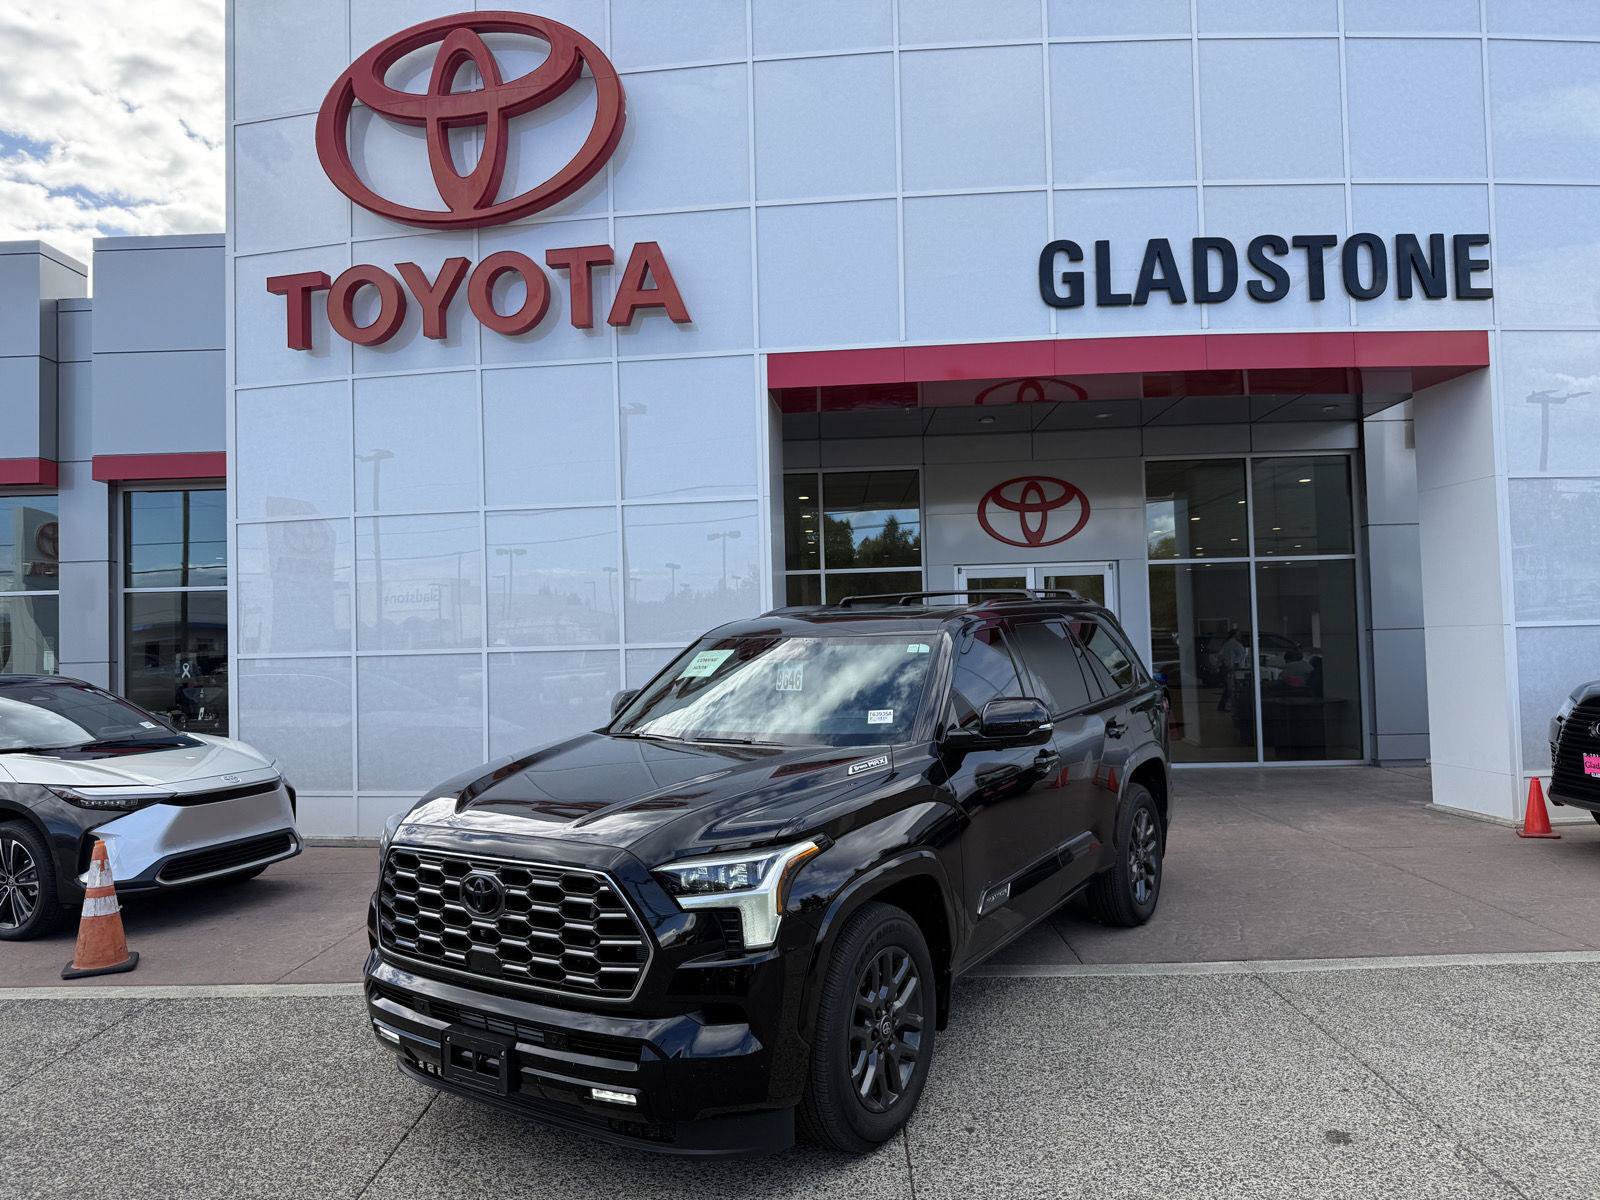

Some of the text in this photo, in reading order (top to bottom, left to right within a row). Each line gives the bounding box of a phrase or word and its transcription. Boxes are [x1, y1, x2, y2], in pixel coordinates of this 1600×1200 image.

[266, 241, 693, 351] TOYOTA
[1038, 232, 1494, 308] GLADSTONE
[776, 670, 801, 689] 9646
